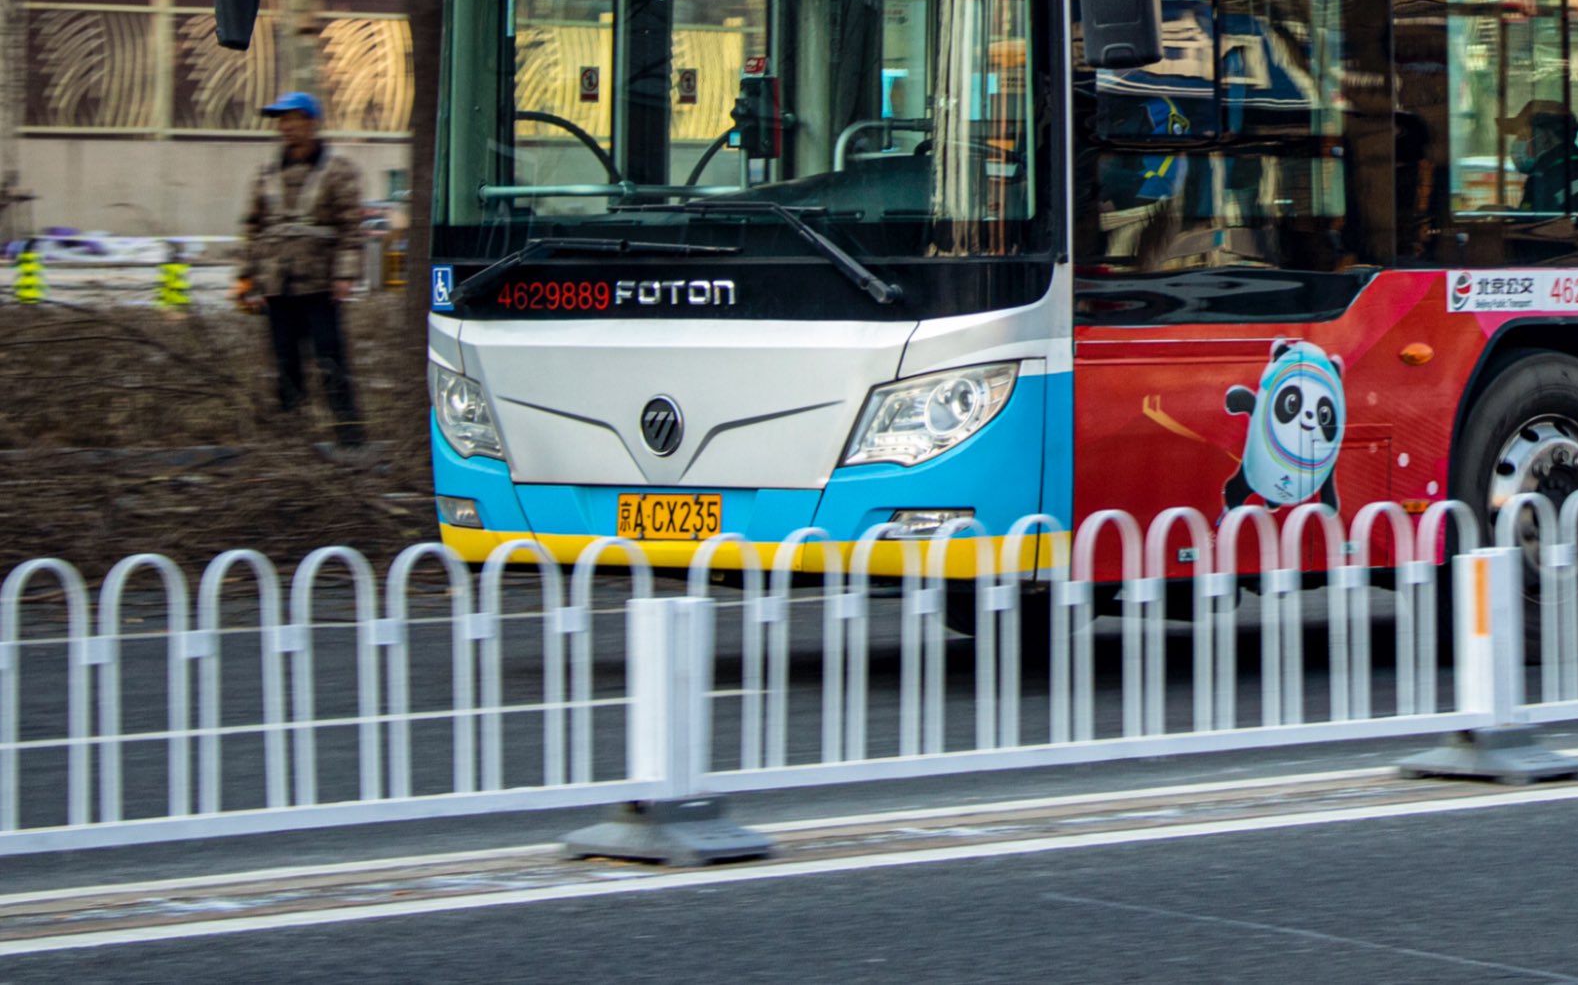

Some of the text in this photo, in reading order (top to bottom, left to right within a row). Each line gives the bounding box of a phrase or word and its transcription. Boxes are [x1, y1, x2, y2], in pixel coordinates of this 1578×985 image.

[497, 282, 611, 310] 4629889
[614, 280, 736, 305] FOTON
[1476, 277, 1535, 295] 北京公交
